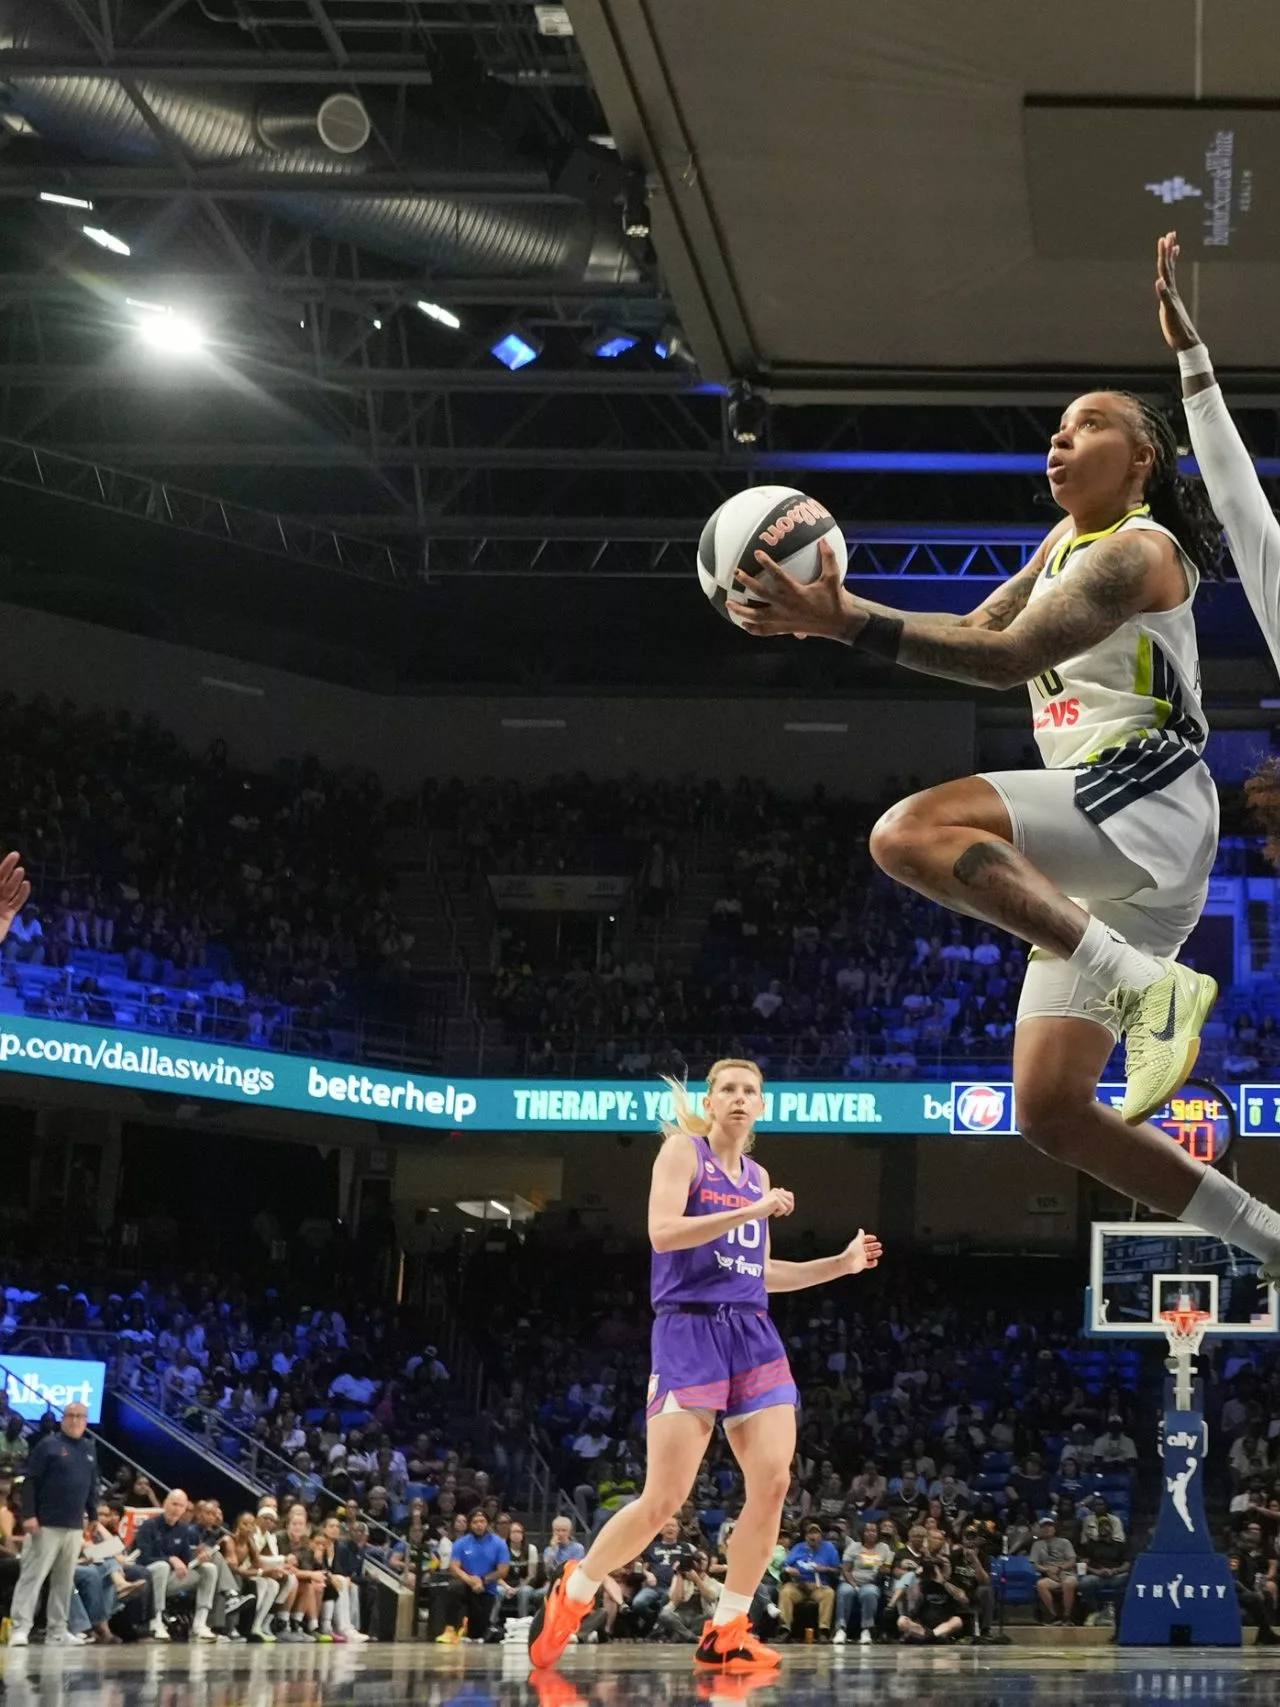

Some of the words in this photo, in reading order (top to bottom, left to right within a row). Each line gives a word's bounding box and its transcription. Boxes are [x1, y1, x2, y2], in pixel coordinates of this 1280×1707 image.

[308, 1067, 477, 1122] betterhelp
[514, 1090, 637, 1120] THERAPY:
[780, 1093, 882, 1122] PLAYER.
[7, 1372, 93, 1407] Albert
